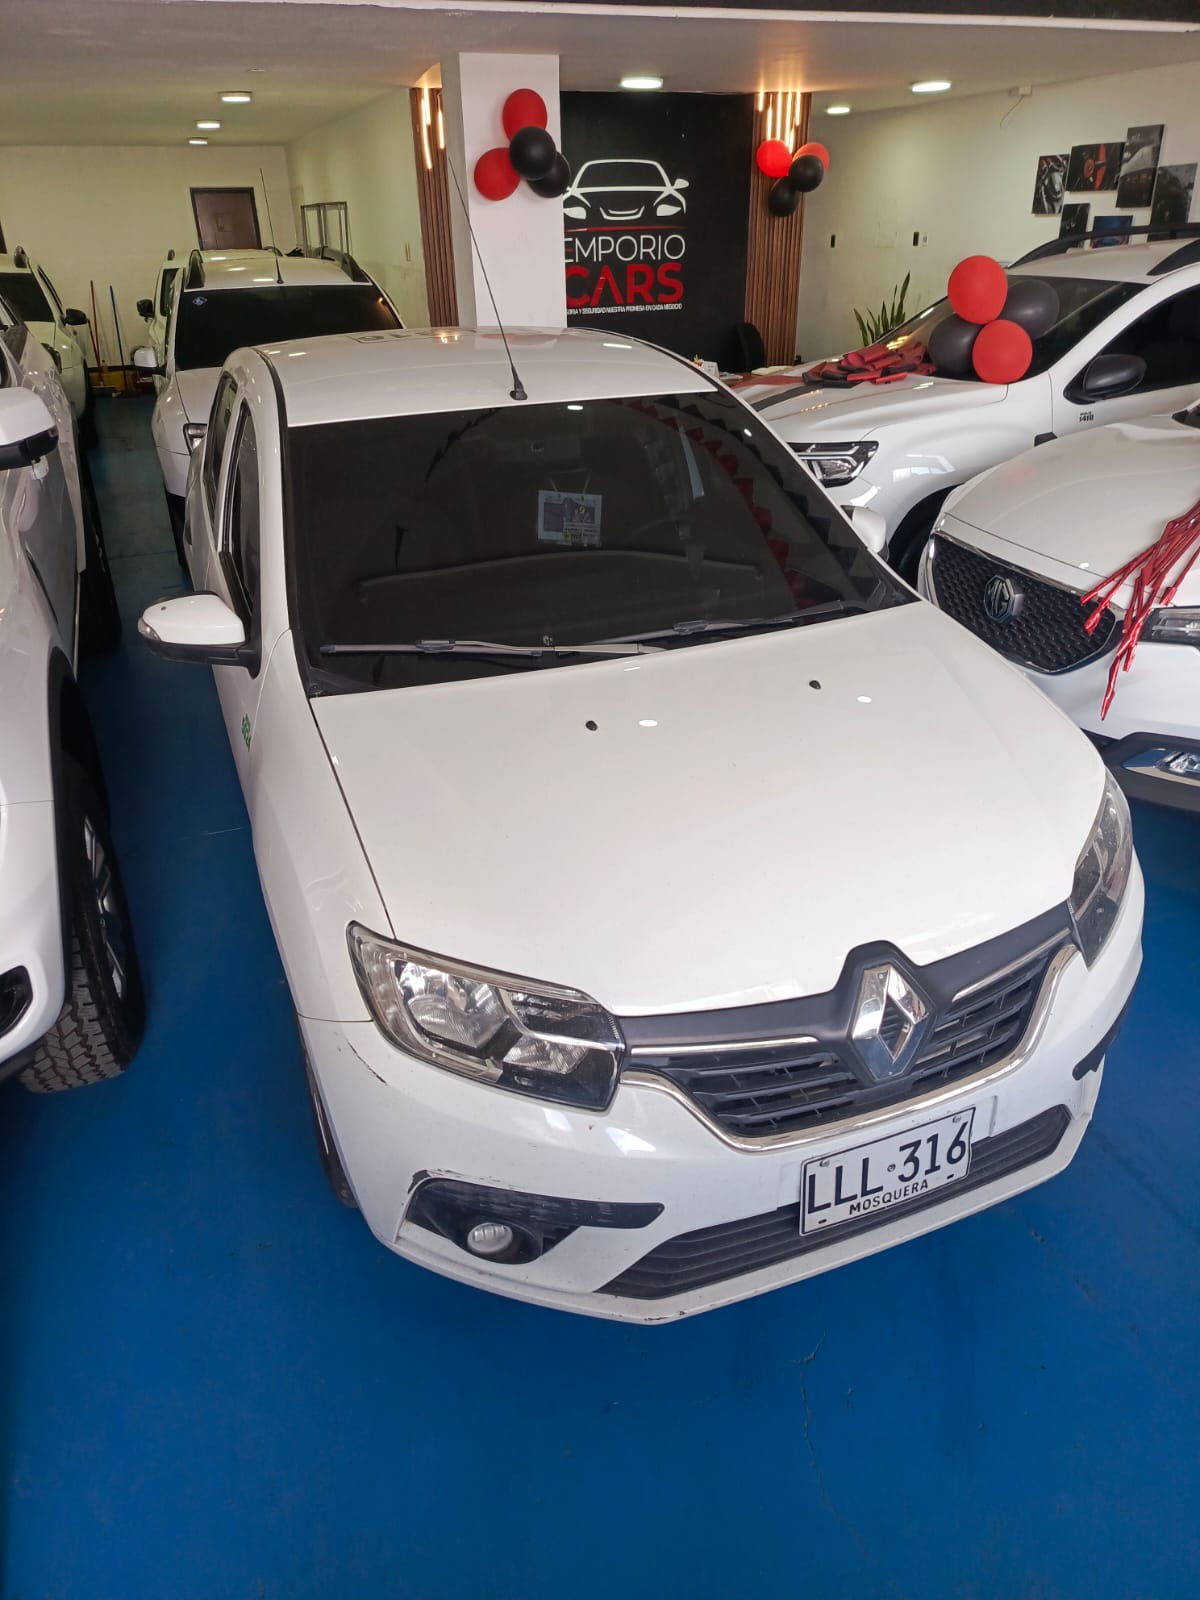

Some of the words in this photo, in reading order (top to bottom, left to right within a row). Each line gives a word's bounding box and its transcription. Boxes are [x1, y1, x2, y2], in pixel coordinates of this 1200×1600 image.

[563, 234, 686, 262] EMPORIO
[565, 262, 684, 308] CARS
[807, 1156, 884, 1215] LLL
[898, 1120, 970, 1183] 316
[849, 1178, 929, 1216] MOSQUERA
